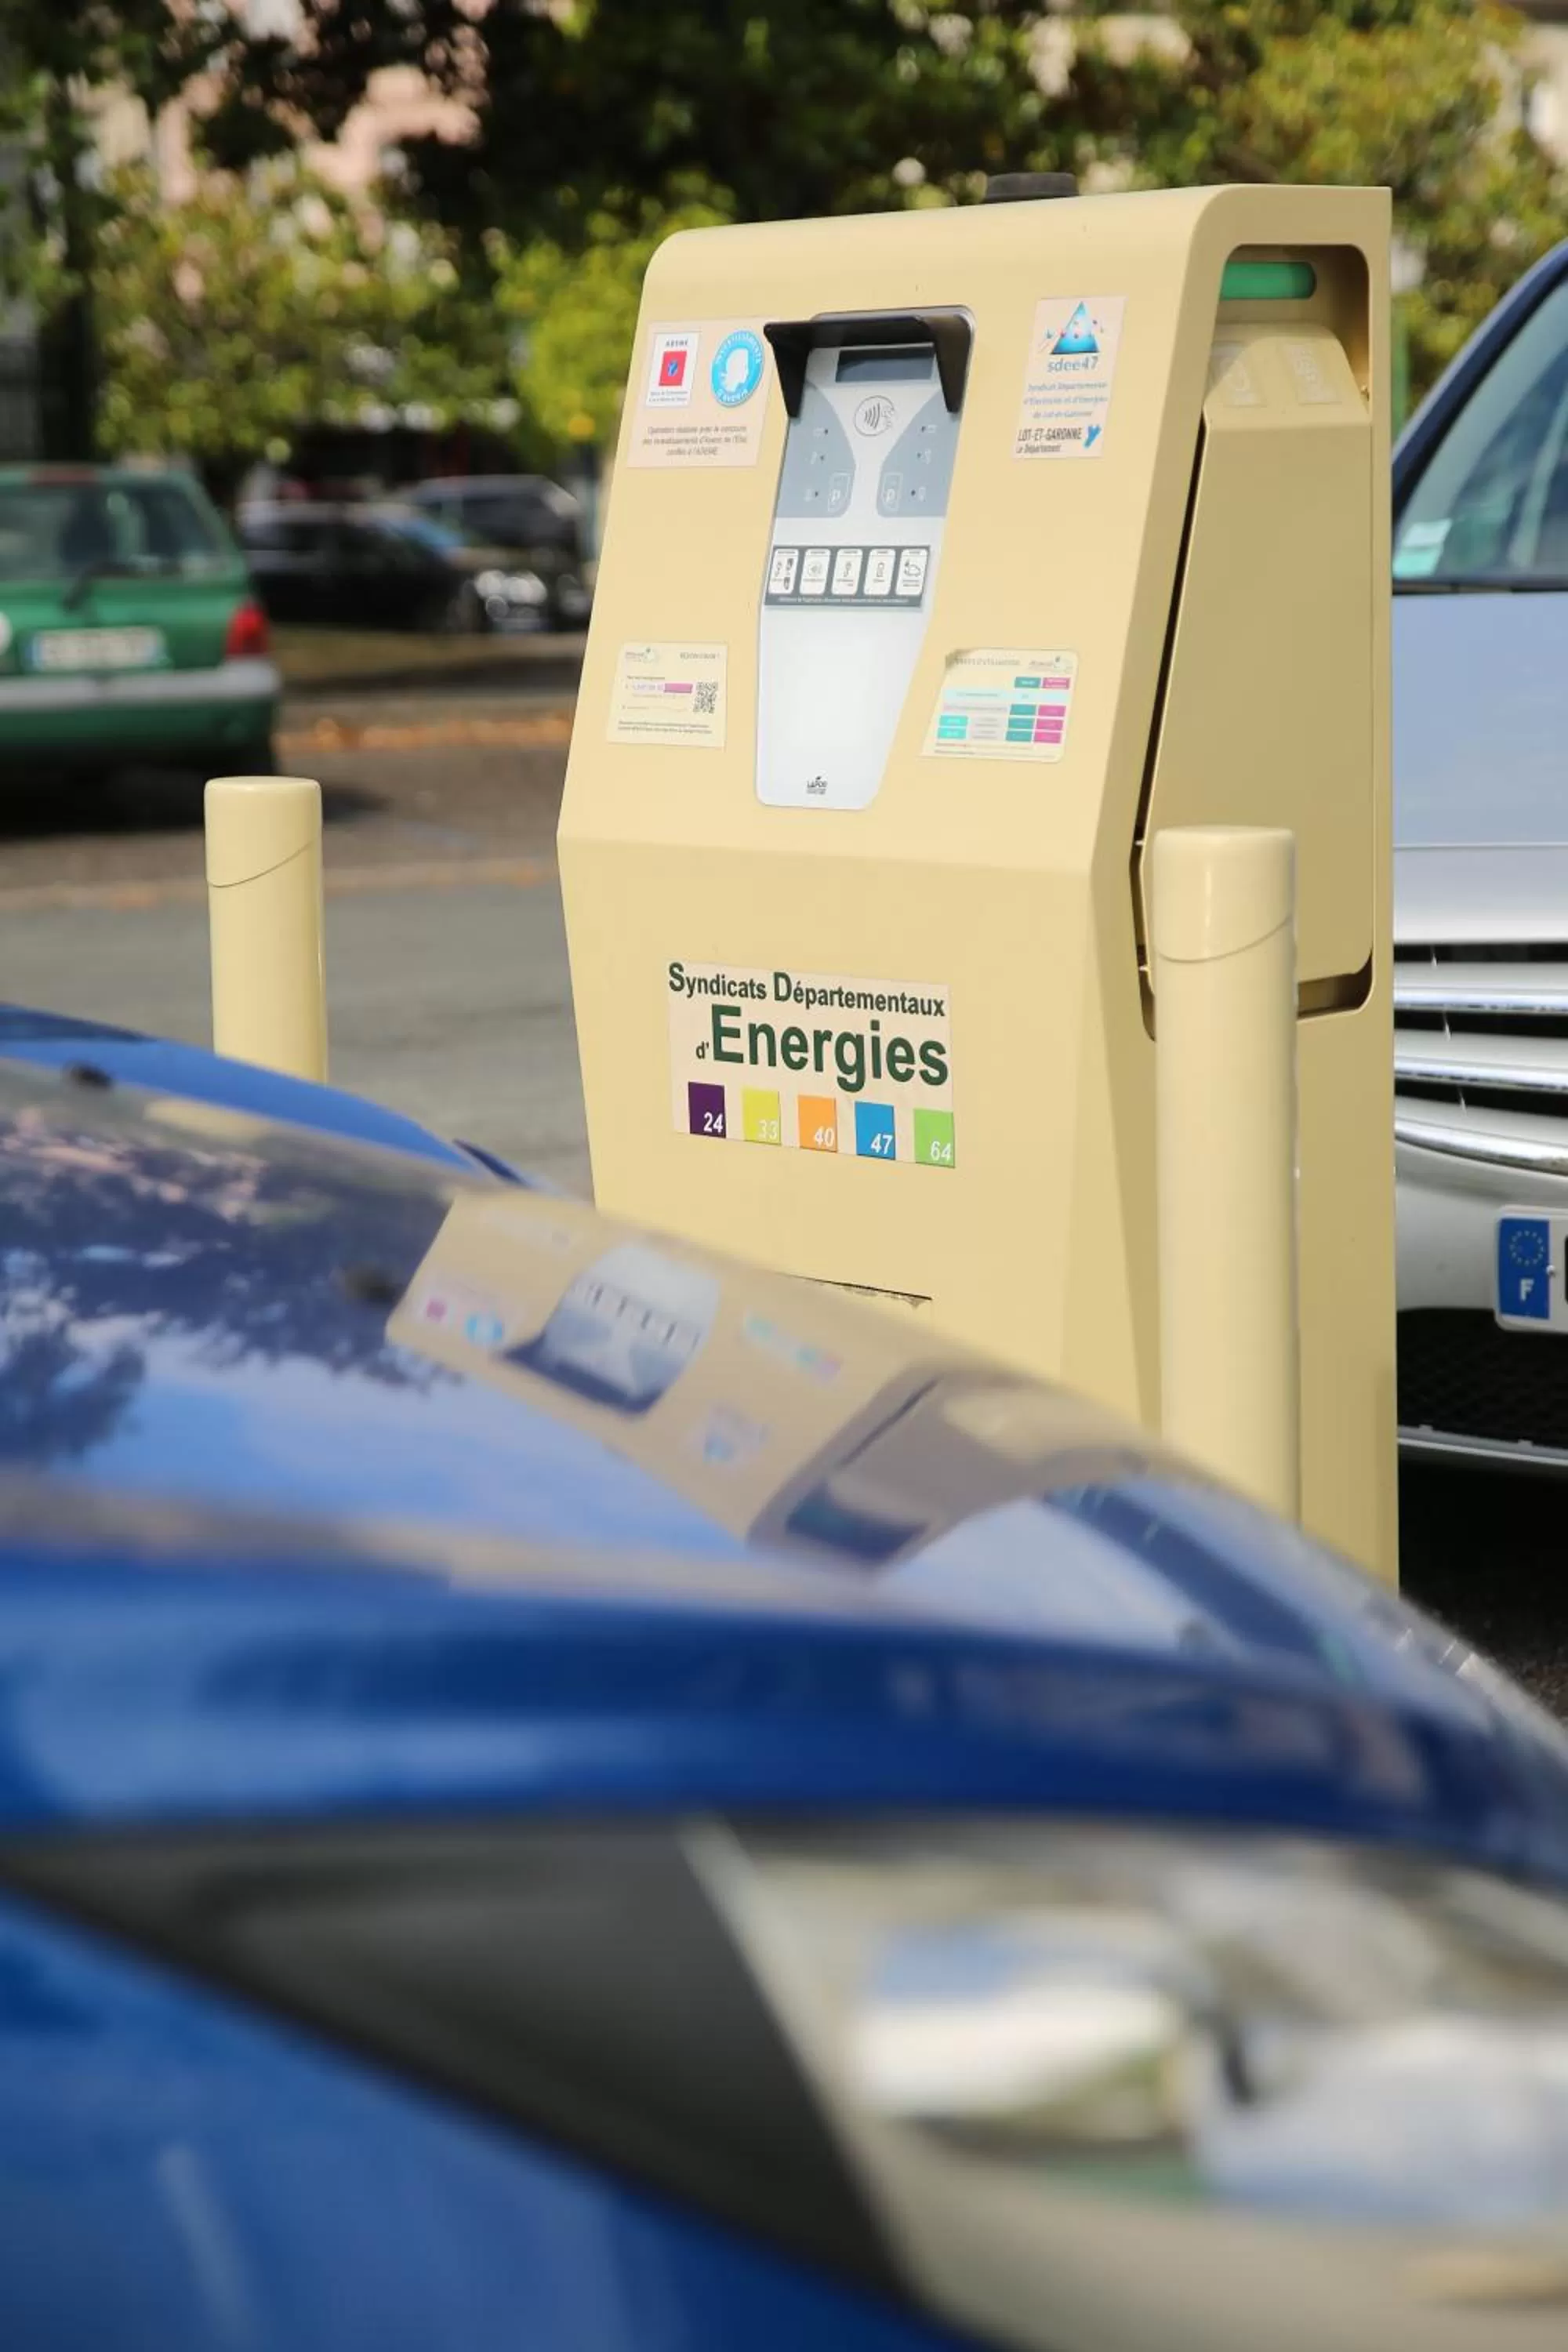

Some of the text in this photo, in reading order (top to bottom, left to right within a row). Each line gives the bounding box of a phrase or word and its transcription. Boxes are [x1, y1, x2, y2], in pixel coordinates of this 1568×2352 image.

[1047, 356, 1098, 372] sdee47
[1018, 428, 1083, 441] LOT-ET-GARONNE
[669, 962, 945, 1017] Syndicats Départementaux
[704, 1112, 952, 1161] 24 33 40 47 64
[1519, 1278, 1534, 1301] F
